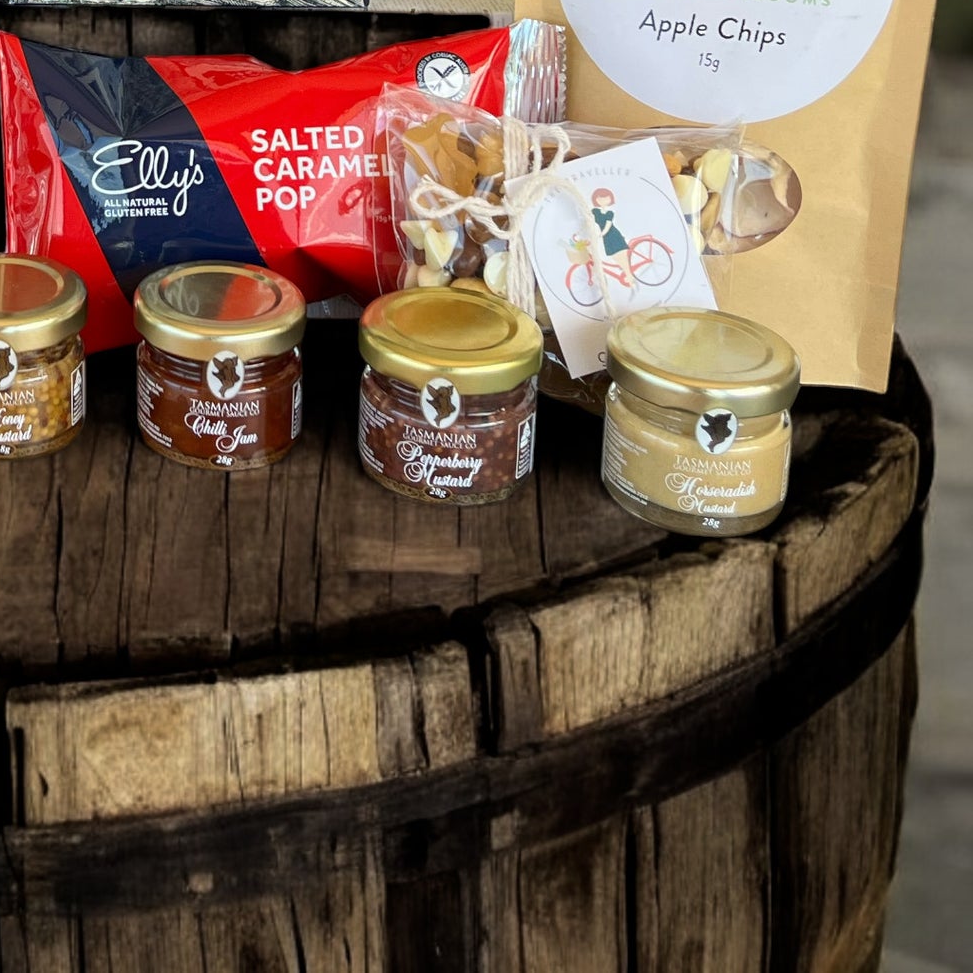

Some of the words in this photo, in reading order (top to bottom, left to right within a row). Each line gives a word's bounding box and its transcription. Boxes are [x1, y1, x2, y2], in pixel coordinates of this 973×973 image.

[639, 9, 708, 43] Apple
[719, 17, 786, 52] Chips
[699, 53, 720, 73] 15g
[251, 125, 364, 153] SALTED
[253, 153, 396, 182] CARAMEL
[91, 139, 205, 217] Elly's
[104, 199, 122, 207] ALL
[123, 197, 169, 207] NATURAL
[255, 185, 317, 211] POP
[104, 207, 144, 217] GLUTEN
[145, 207, 169, 217] FREE
[189, 398, 259, 412] TASMANIAN
[183, 413, 227, 439] Chilli
[215, 425, 258, 453] Jam
[404, 423, 476, 443] TASMANIAN
[215, 455, 233, 466] 28g
[396, 440, 483, 475] Pepperberry
[675, 454, 751, 470] TASMANIAN
[403, 461, 473, 488] Mustard
[665, 472, 757, 497] Horseradish
[429, 487, 447, 499] 28g
[677, 494, 737, 513] Mustard
[701, 517, 721, 529] 28g
